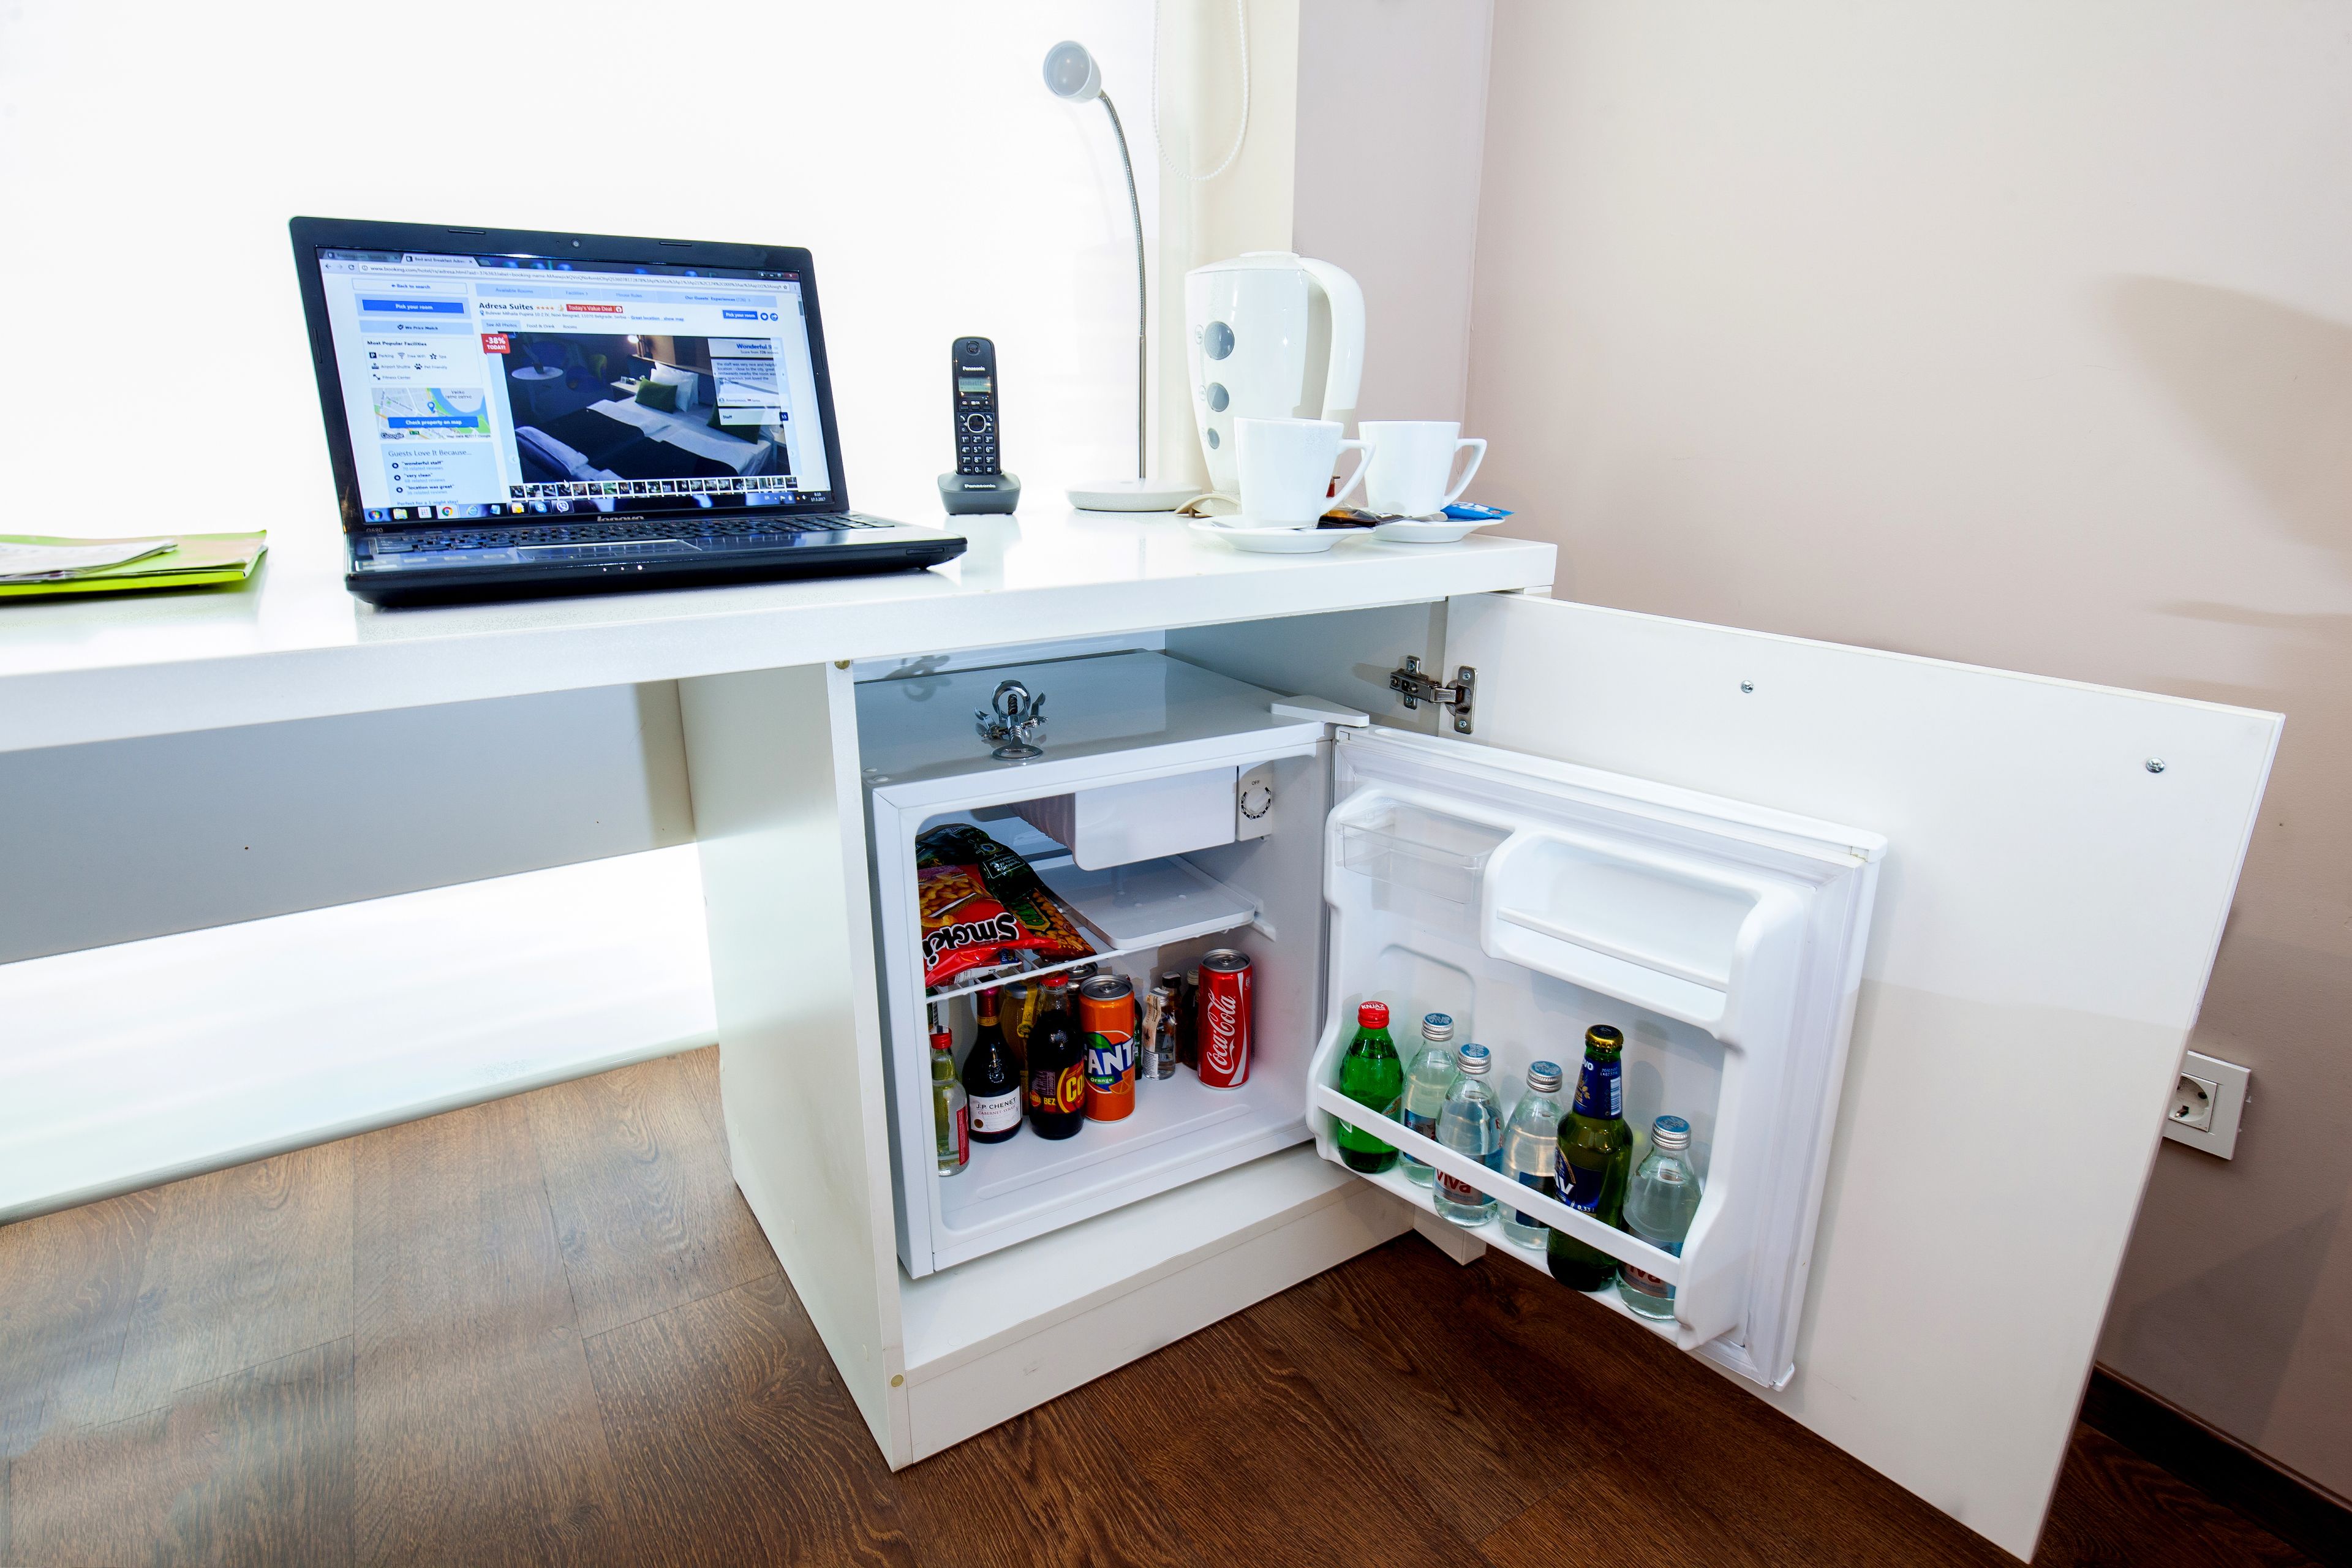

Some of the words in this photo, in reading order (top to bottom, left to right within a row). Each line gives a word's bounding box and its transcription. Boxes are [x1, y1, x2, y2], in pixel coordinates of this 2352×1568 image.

[922, 913, 1019, 965] Smoki
[1084, 1038, 1134, 1075] ANT
[989, 1096, 1016, 1109] CHENET
